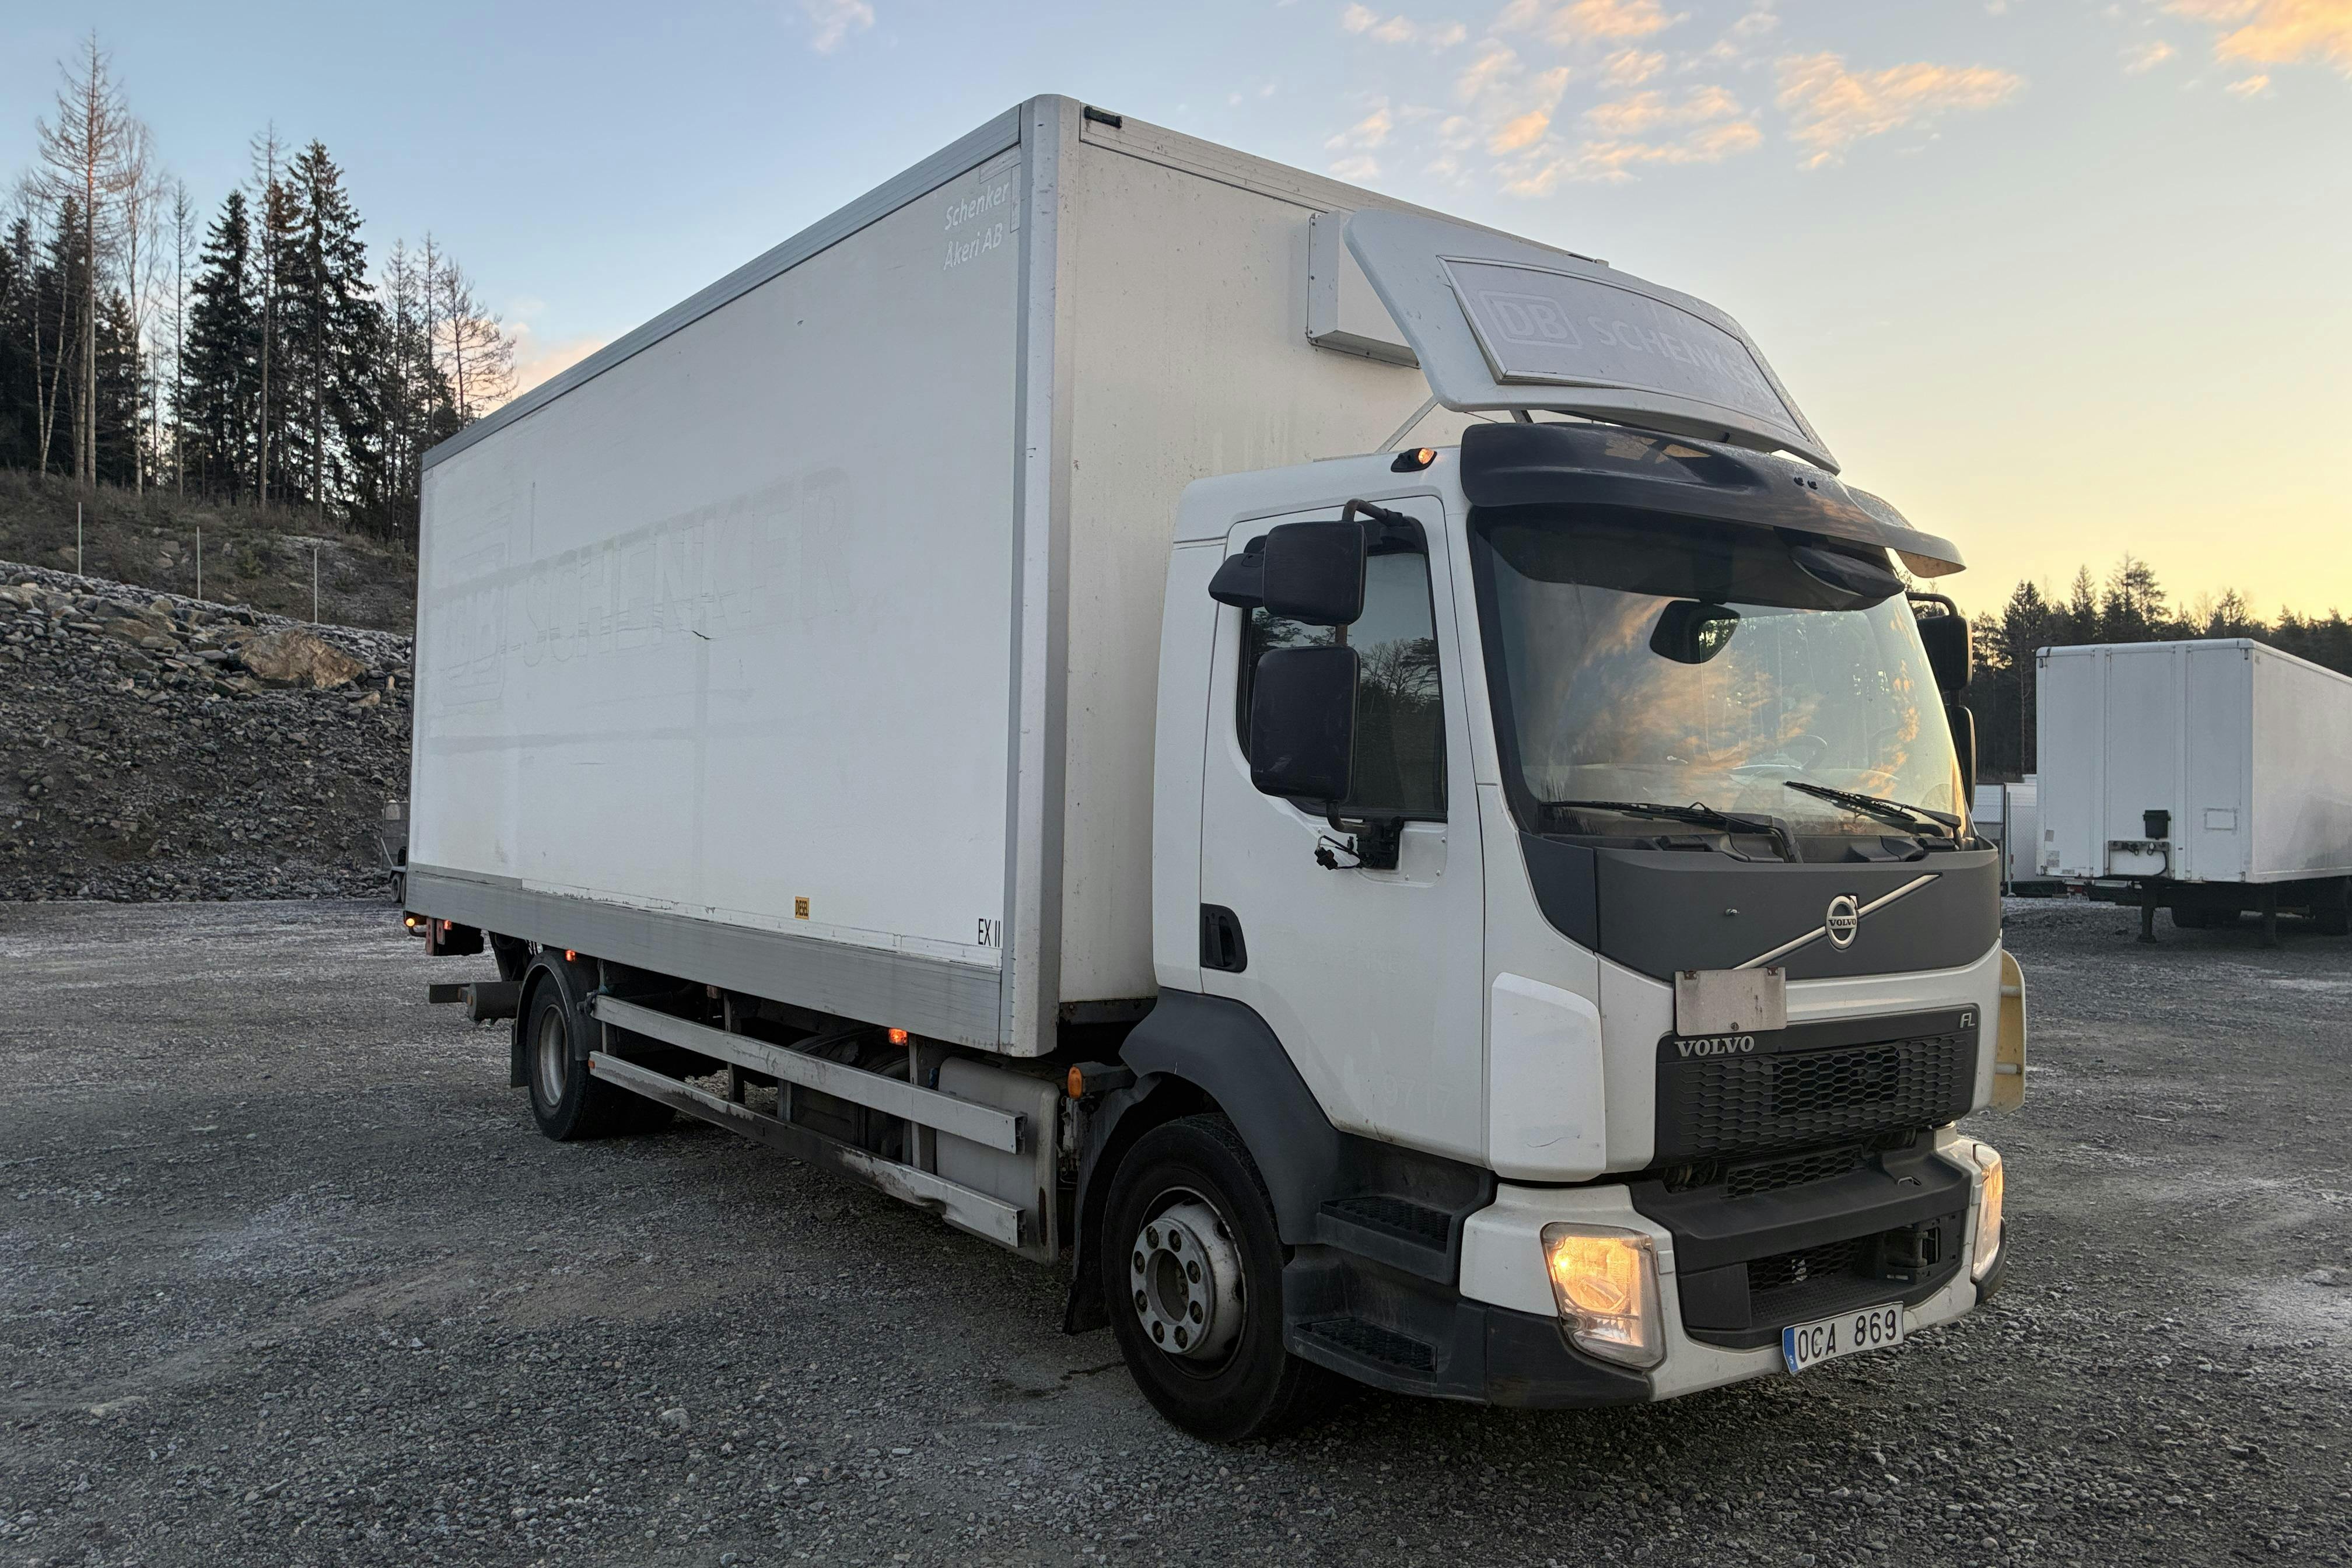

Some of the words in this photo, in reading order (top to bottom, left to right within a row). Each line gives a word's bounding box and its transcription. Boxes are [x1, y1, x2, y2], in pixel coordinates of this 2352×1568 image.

[944, 182, 1009, 230] Schenker
[943, 232, 981, 271] Åkeri
[982, 222, 1003, 253] AB
[1493, 299, 1568, 340] DB
[523, 467, 855, 668] SCHENKER
[978, 918, 992, 946] EX
[995, 920, 1000, 948] II
[1828, 918, 1856, 926] VOLVO
[1960, 1012, 1975, 1028] FL
[1674, 1035, 1755, 1057] VOLVO
[1798, 1322, 1836, 1363] OCA
[1854, 1309, 1896, 1347] 869
[1788, 1354, 1794, 1365] S
